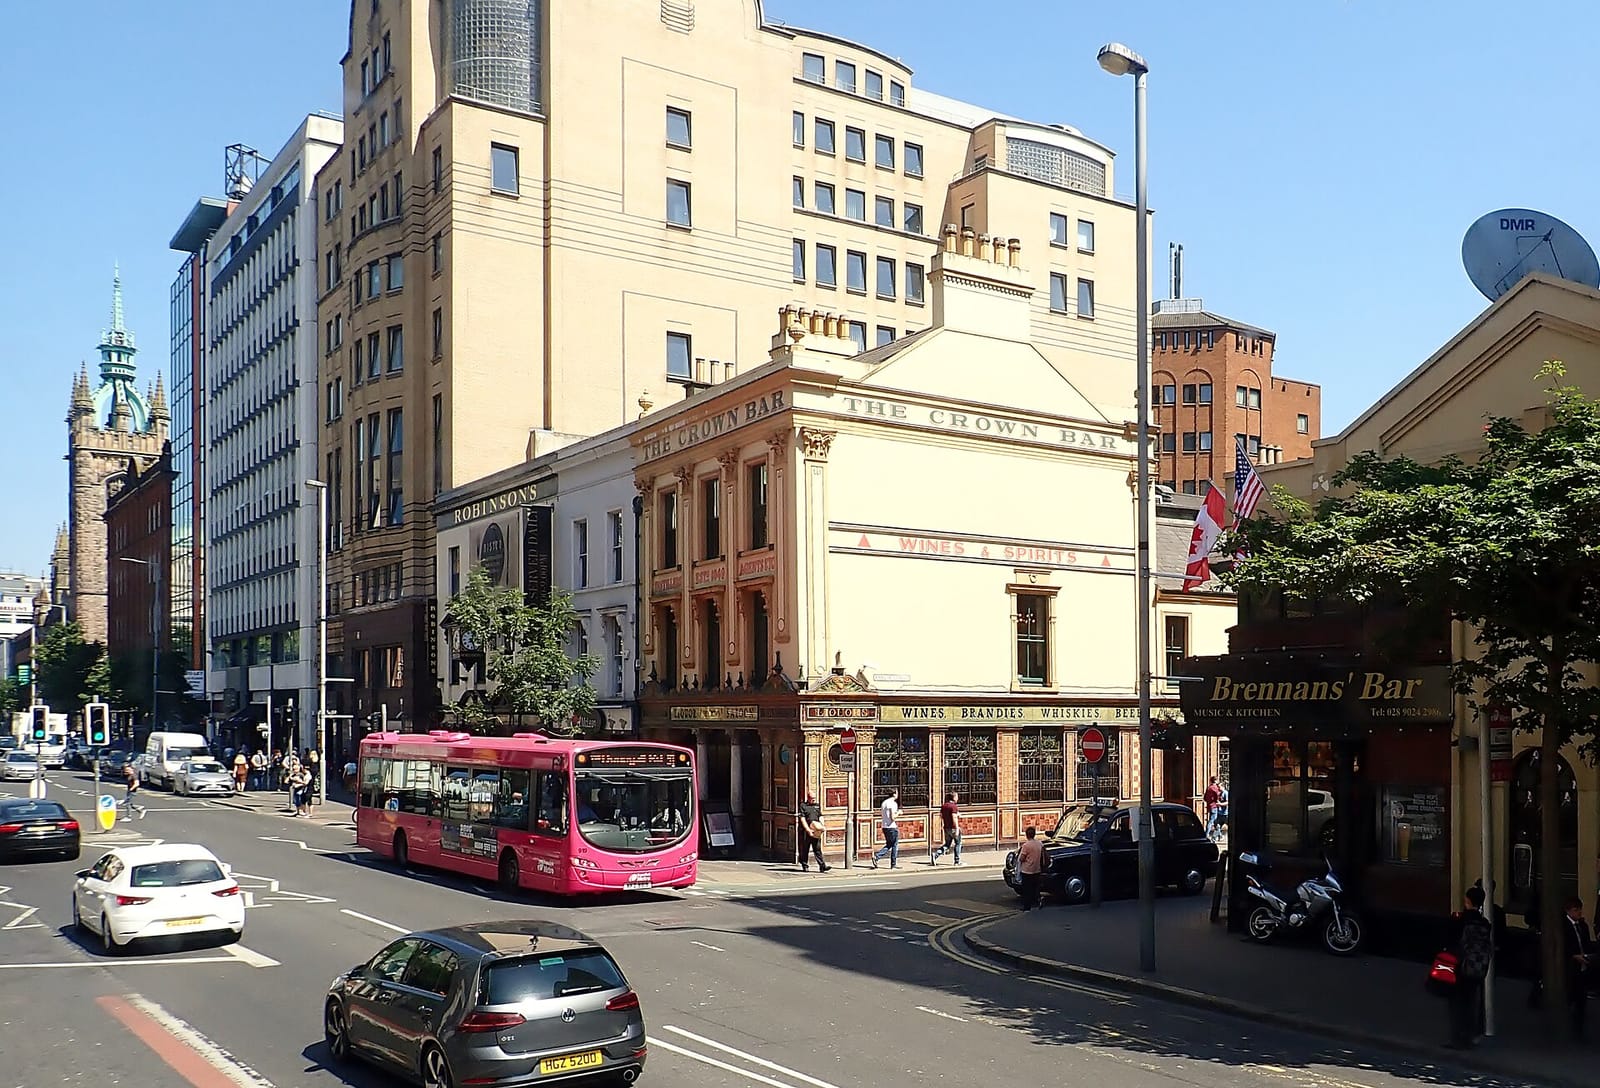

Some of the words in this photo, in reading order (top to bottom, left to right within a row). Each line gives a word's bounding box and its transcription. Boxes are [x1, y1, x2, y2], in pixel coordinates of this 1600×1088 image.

[1500, 218, 1535, 231] DMR
[643, 436, 671, 461] THE
[679, 407, 739, 446] CROWN
[745, 390, 785, 421] BAR
[843, 397, 907, 419] THE
[929, 410, 1038, 438] CROWN
[1060, 429, 1117, 449] BAR
[454, 484, 537, 524] ROBINSON'S
[898, 537, 965, 554] WINES
[981, 545, 989, 558] &
[1003, 546, 1077, 563] SPIRITS
[1211, 672, 1354, 701] Brennans'
[1358, 672, 1424, 700] Bar
[1193, 708, 1225, 718] MUSIC
[1226, 708, 1233, 718] &
[1236, 708, 1281, 718] KITCHEN
[545, 1058, 566, 1071] HGZ
[570, 1053, 597, 1067] 5200
